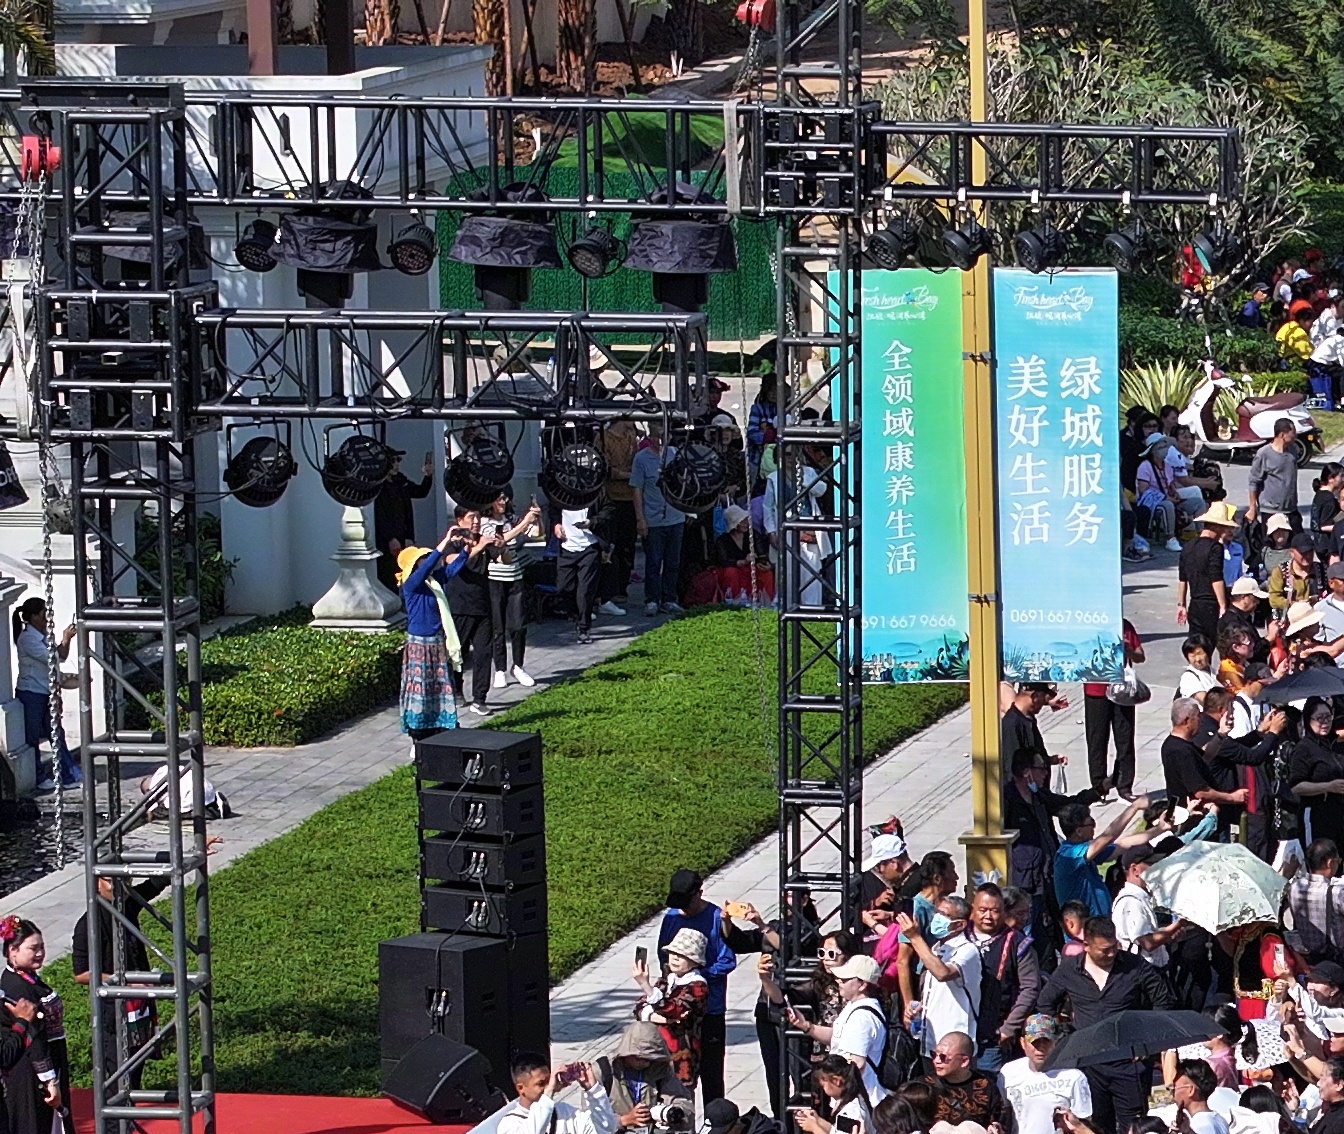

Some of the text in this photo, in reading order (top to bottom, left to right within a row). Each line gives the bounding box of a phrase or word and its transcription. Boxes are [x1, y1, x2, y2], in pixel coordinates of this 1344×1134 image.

[881, 339, 917, 575] 全领域康养生活
[1007, 354, 1050, 547] 美好生活
[1060, 357, 1105, 546] 绿城服务
